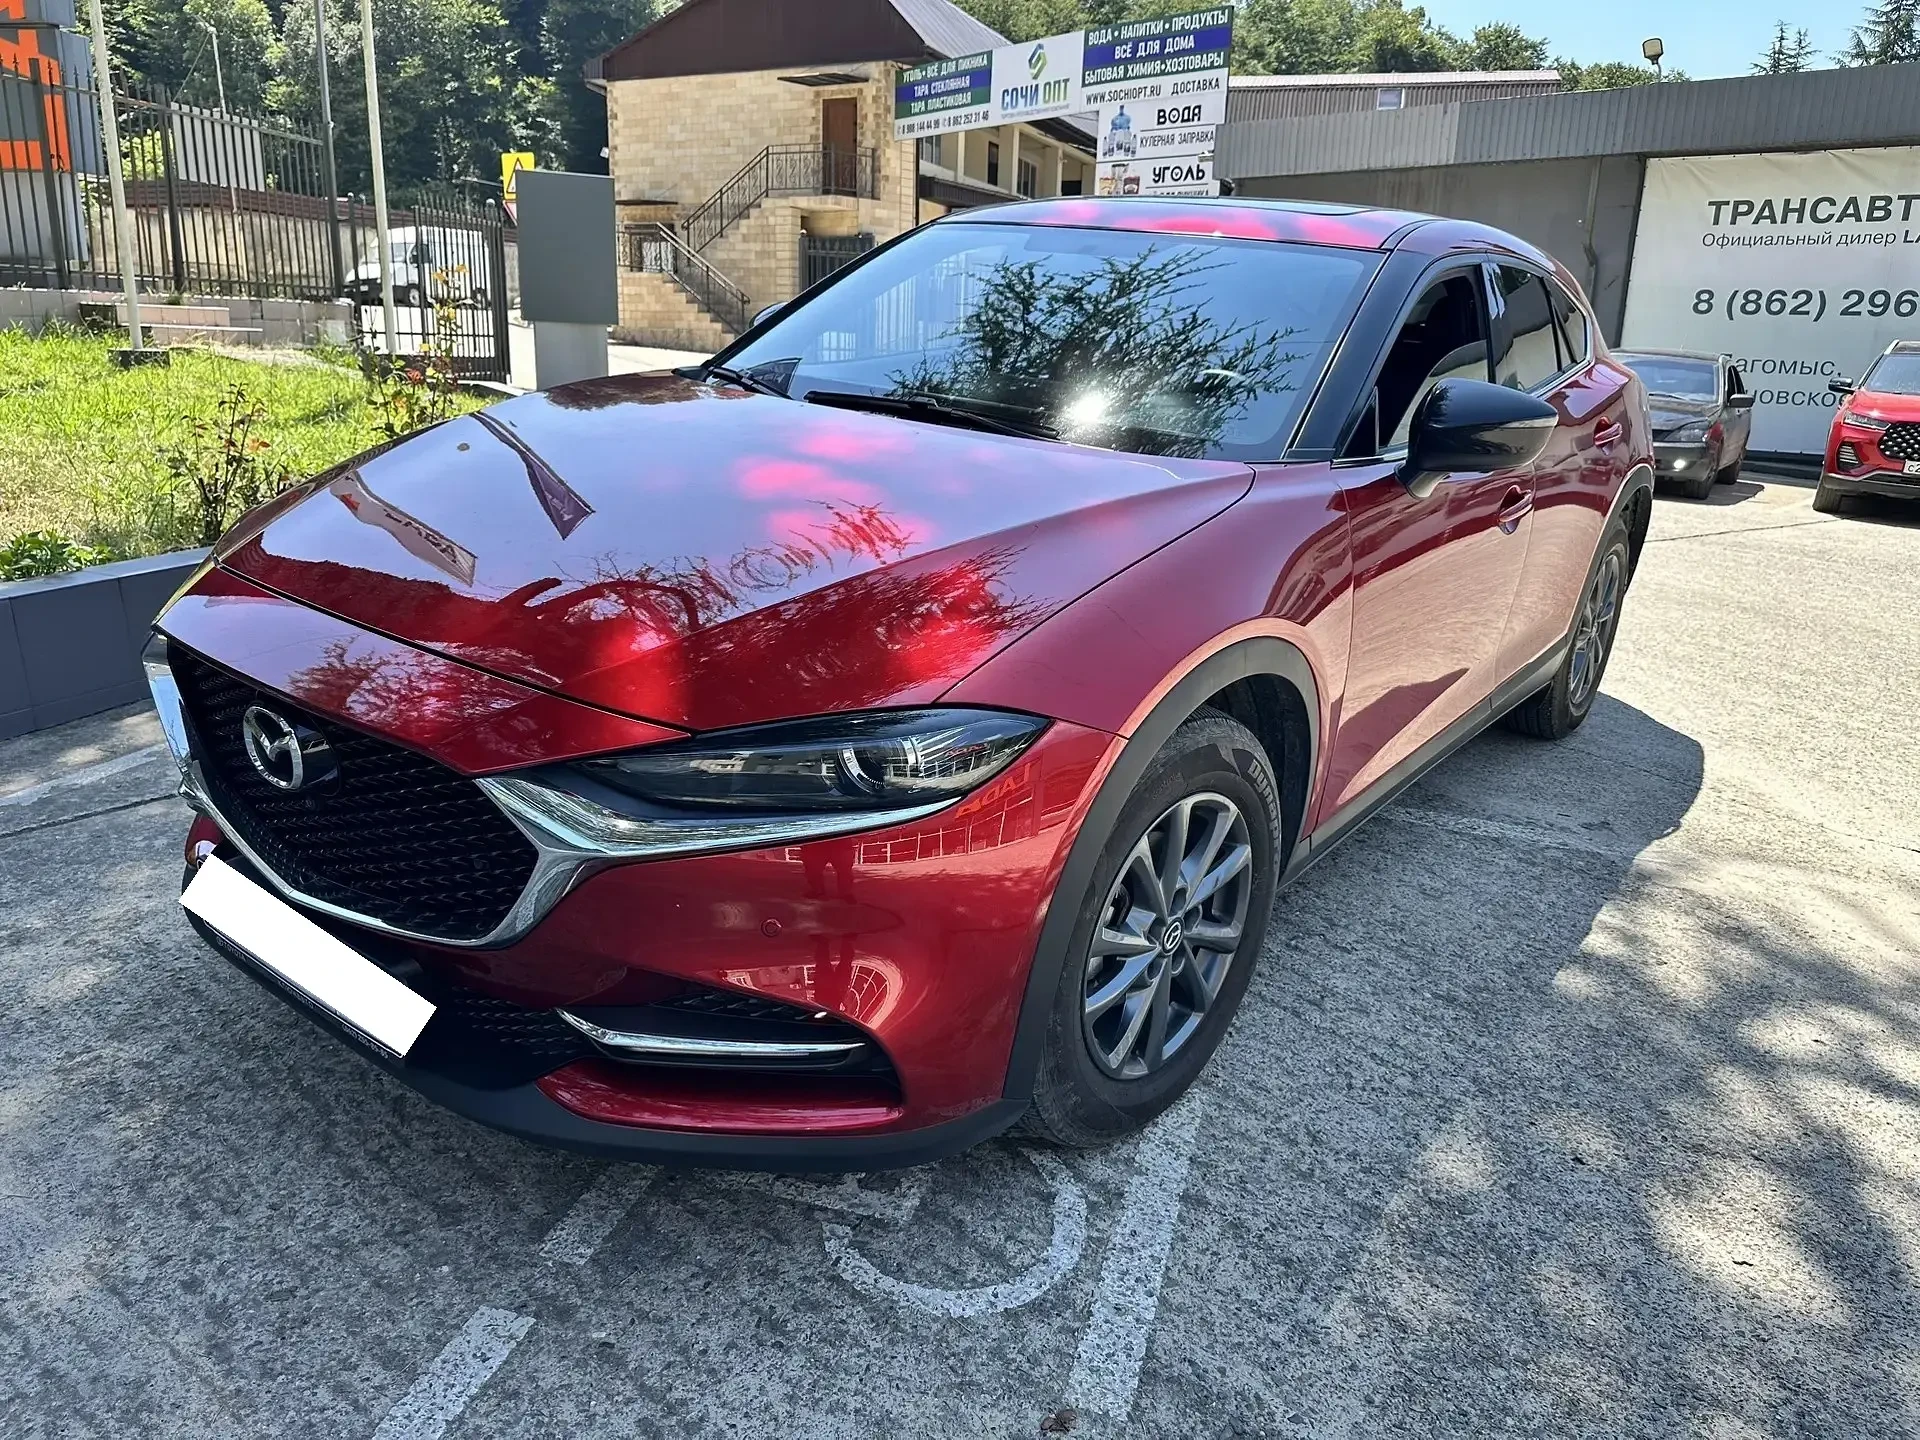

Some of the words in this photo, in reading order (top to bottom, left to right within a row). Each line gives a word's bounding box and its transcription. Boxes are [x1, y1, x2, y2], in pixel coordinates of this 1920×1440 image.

[1088, 28, 1112, 46] ВОДА
[1120, 20, 1164, 39] НАПИТКИ
[1171, 9, 1229, 32] ПРОДУКТЫ
[1114, 41, 1133, 60] ВСЁ
[1136, 39, 1160, 58] ДЛЯ
[1164, 34, 1195, 54] ДОМА
[903, 68, 922, 83] УГОЛЬ
[940, 60, 956, 76] ДЛЯ
[957, 54, 988, 71] ПИКНИКА
[1084, 65, 1124, 84] БЫТОВАЯ
[1126, 60, 1161, 78] ХИМИЯ
[1165, 51, 1224, 75] ХОЗТОВАРЫ
[913, 84, 929, 98] ТАРА
[930, 75, 970, 94] СТЕКЛЯННАЯ
[1001, 83, 1039, 112] СОЧИ
[1043, 77, 1070, 104] ОПТ
[1086, 84, 1161, 105] WWW.SOCHIOPT.RU
[1171, 77, 1220, 97] ДОСТАВКА
[911, 100, 926, 114] ТАРА
[927, 91, 972, 111] ПЛАСТИКОВАЯ
[1157, 104, 1202, 125] ВОДА
[1140, 133, 1176, 148] КУЛЕРНАЯ
[1178, 130, 1214, 145] ЗАПРАВКА
[1152, 163, 1206, 183] УГОЛЬ
[1707, 194, 1920, 226] ТРАНСАВТ
[1702, 231, 1832, 249] Официальный
[1836, 231, 1897, 248] дилер
[1692, 288, 1716, 315] 8
[1726, 289, 1827, 322] (862)
[1839, 289, 1920, 318] 296
